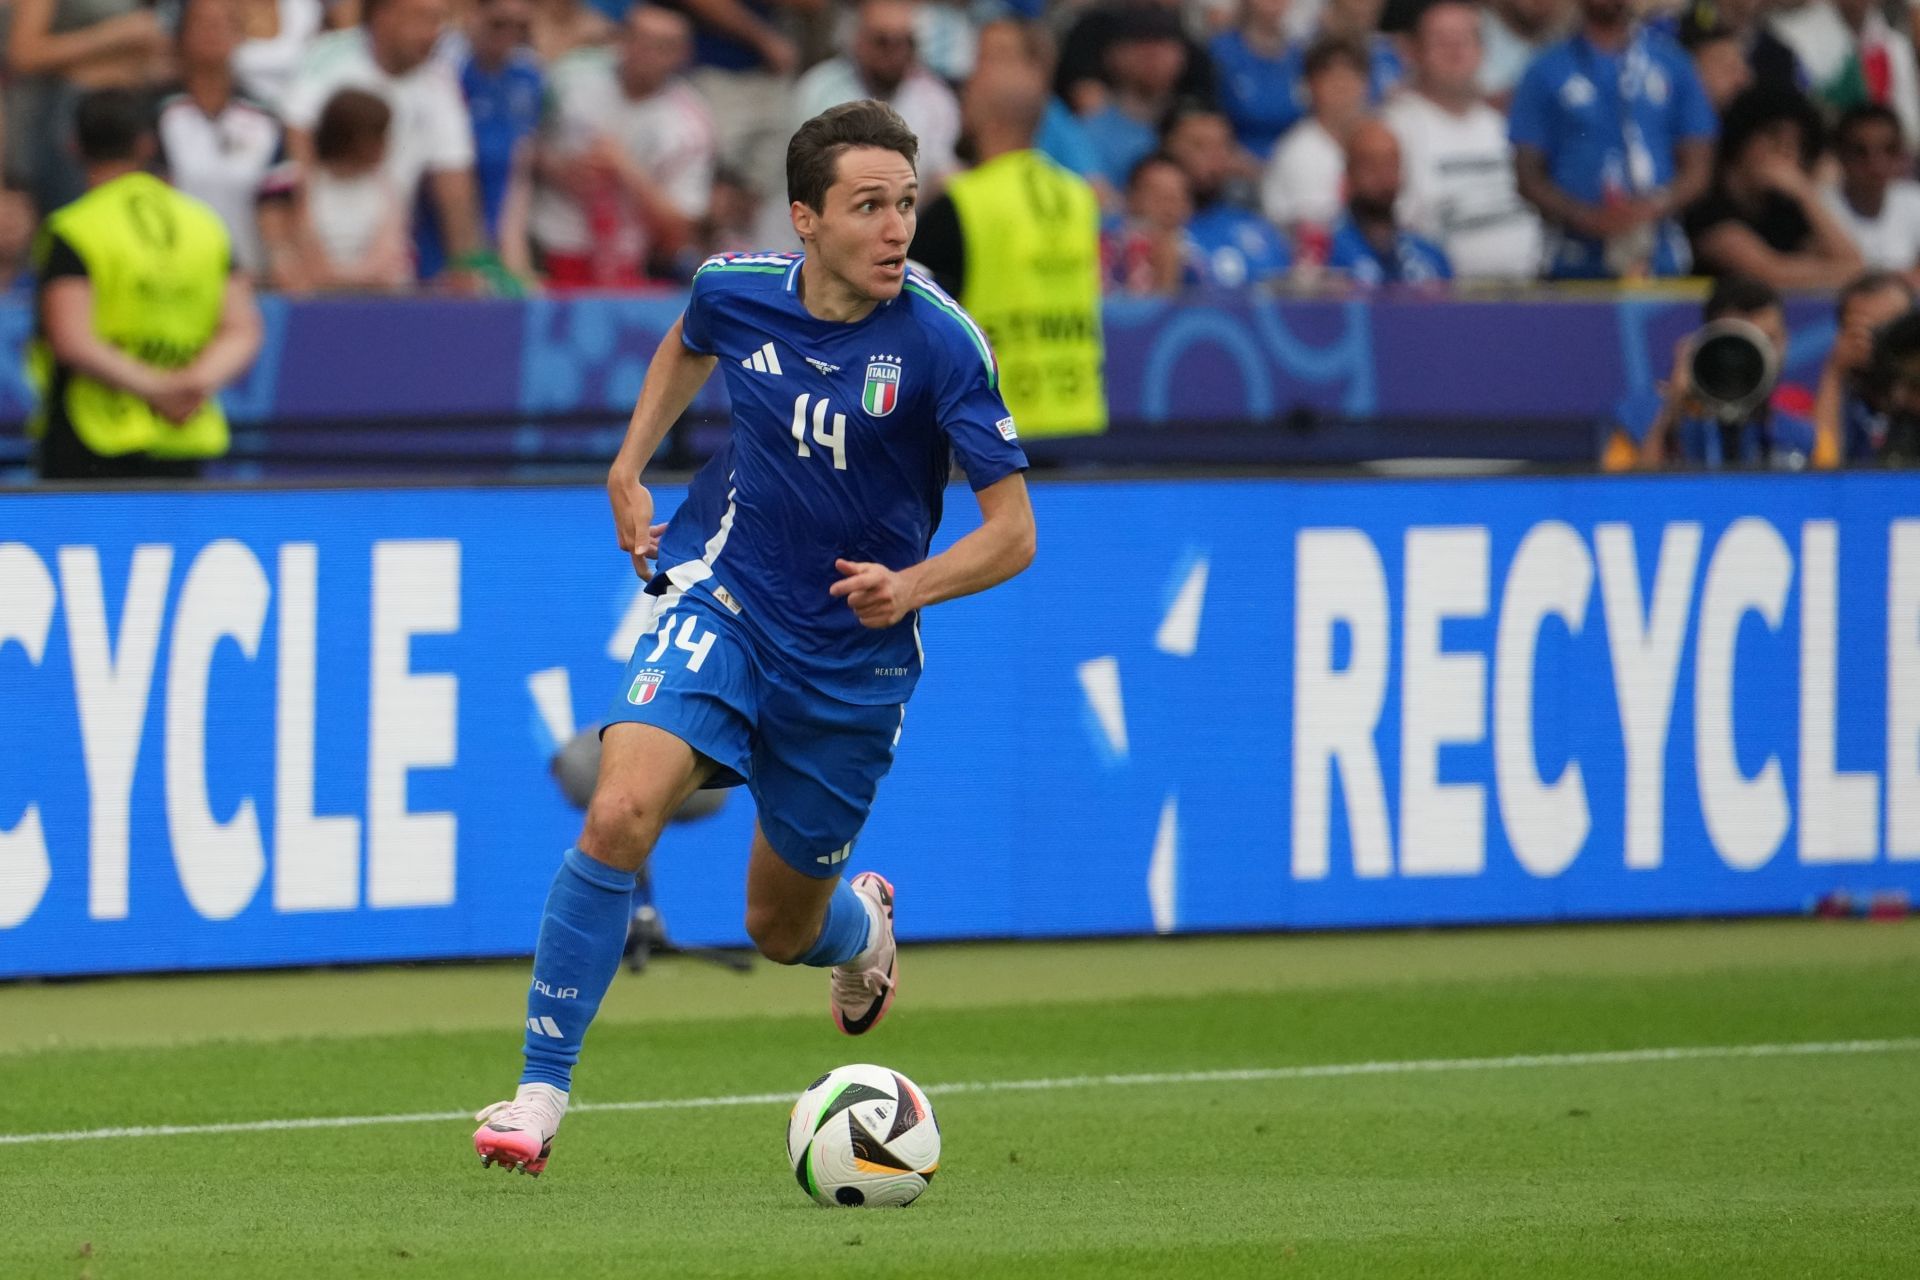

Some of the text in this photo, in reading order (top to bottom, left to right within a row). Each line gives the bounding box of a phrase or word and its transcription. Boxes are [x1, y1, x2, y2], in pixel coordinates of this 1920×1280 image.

[868, 367, 897, 380] ITALIA
[792, 393, 847, 470] 14
[645, 613, 717, 673] 14
